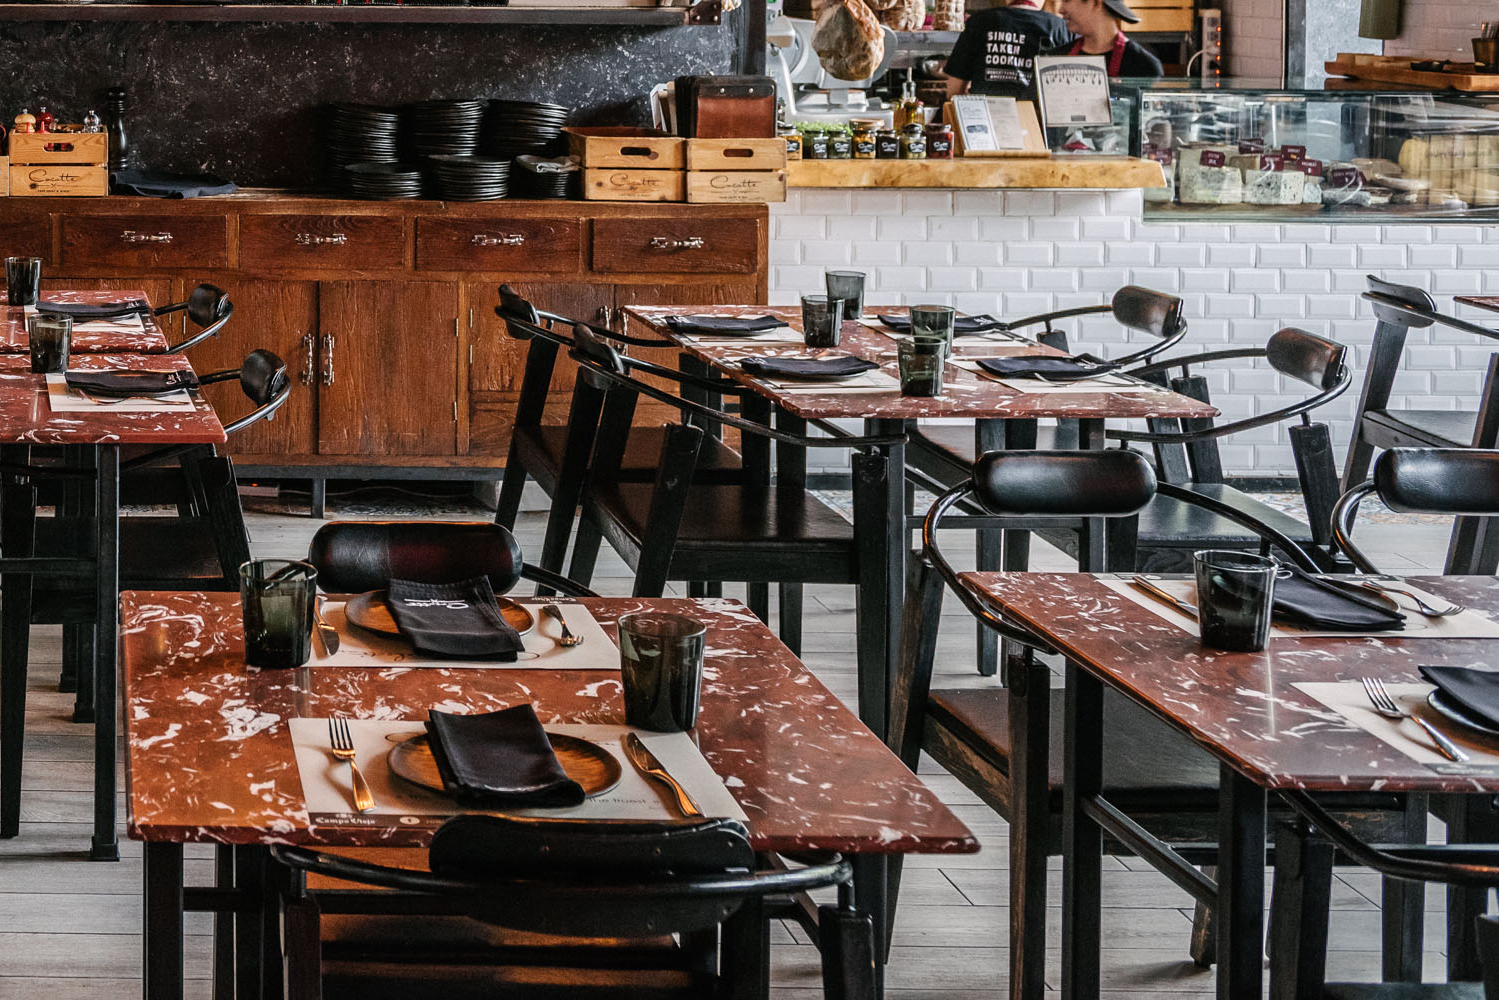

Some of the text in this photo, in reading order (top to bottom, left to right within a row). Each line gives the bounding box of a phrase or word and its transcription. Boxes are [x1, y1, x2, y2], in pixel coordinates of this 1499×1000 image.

[987, 31, 1026, 45] SINGLE
[986, 43, 1021, 55] TAKEN
[985, 54, 1033, 68] COOKING
[315, 816, 350, 825] Campo
